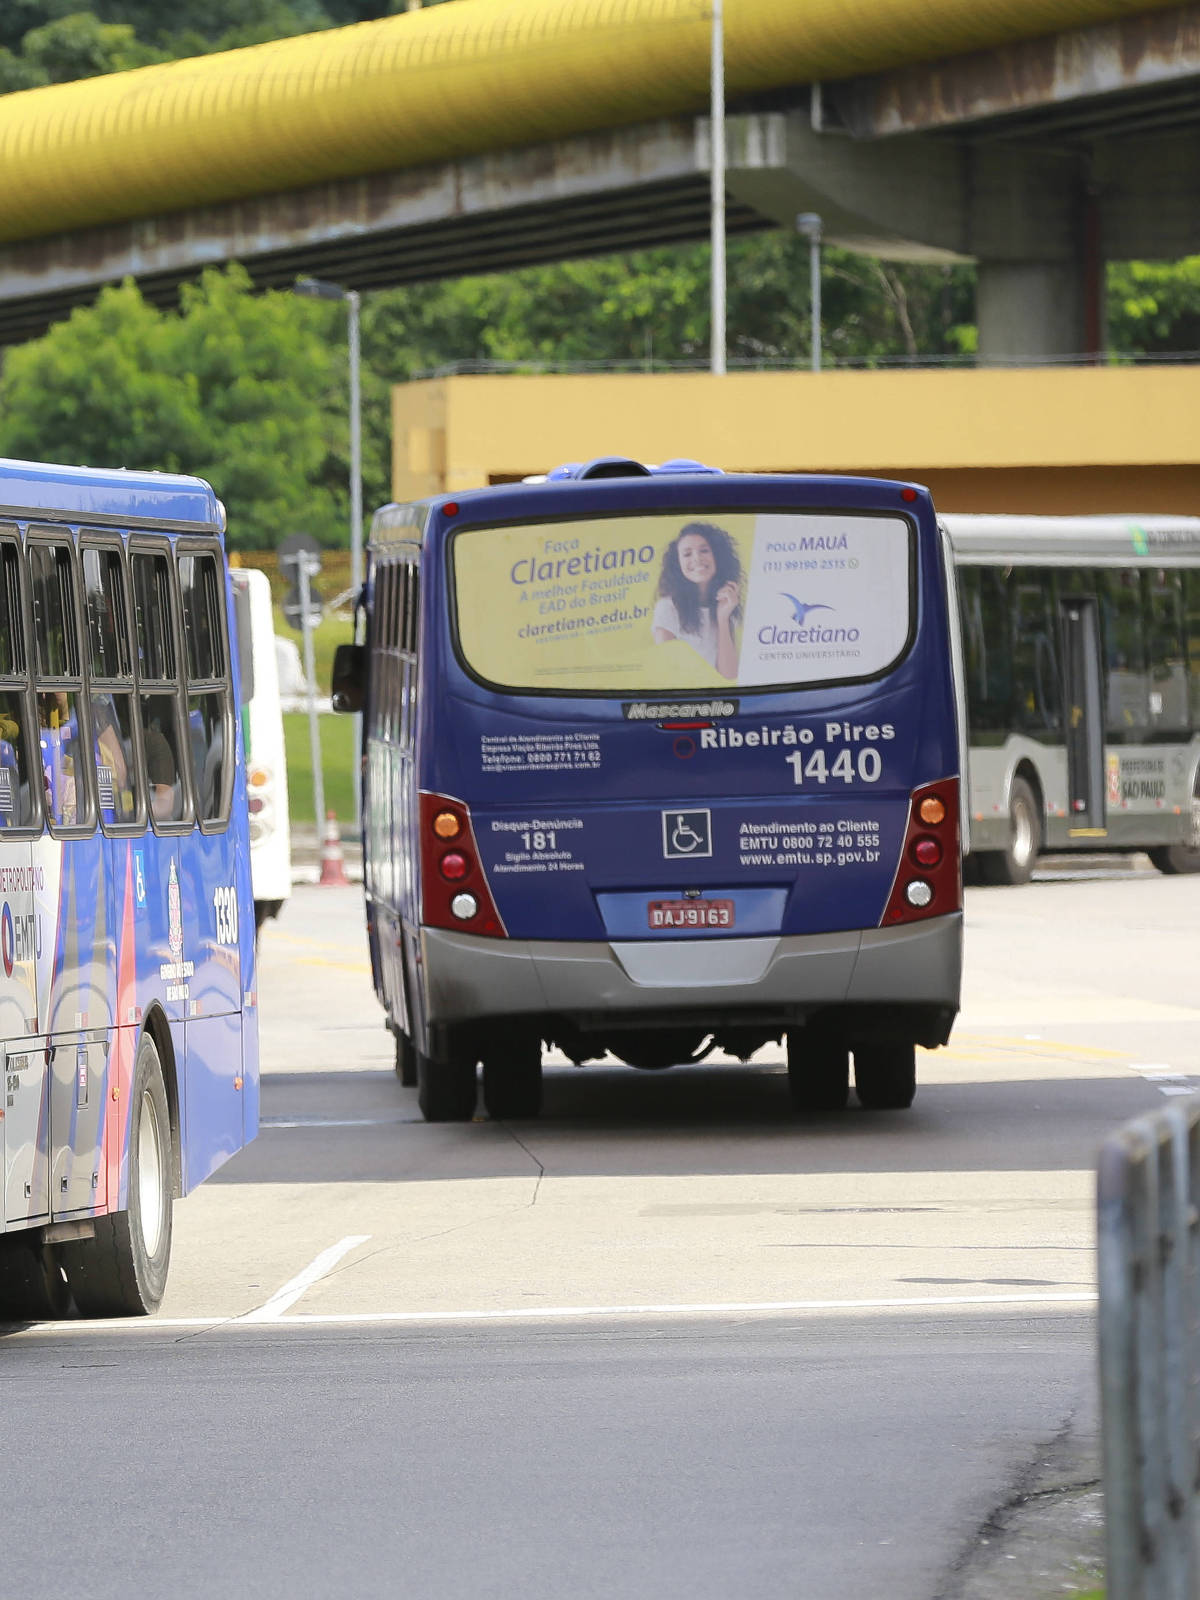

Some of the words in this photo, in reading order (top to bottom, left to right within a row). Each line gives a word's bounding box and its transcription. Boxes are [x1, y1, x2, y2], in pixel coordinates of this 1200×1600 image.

[800, 532, 848, 551] MAUÁ
[510, 544, 655, 585] Claretiano
[519, 589, 530, 604] A
[531, 584, 578, 601] melhor
[581, 571, 650, 596] Faculdade
[538, 600, 567, 616] EAD
[569, 595, 587, 609] do
[517, 606, 650, 639] claretiano.edu.br
[758, 624, 860, 645] Claretiano
[759, 652, 794, 661] CENTRO
[627, 701, 735, 719] Mascarello
[700, 724, 814, 749] Ribeirão
[826, 722, 896, 743] Pires
[785, 747, 882, 785] 1440
[739, 820, 816, 835] Atendimento
[818, 822, 834, 833] ao
[837, 819, 880, 833] Cliente
[520, 830, 556, 850] 181
[740, 837, 779, 851] EMTU
[782, 836, 814, 849] 0800
[817, 836, 833, 849] 72
[836, 835, 853, 848] 40
[856, 834, 880, 847] 555
[739, 851, 881, 867] www.emtu.sp.gov.br
[213, 886, 239, 945] 1330
[14, 914, 42, 961] EMTU
